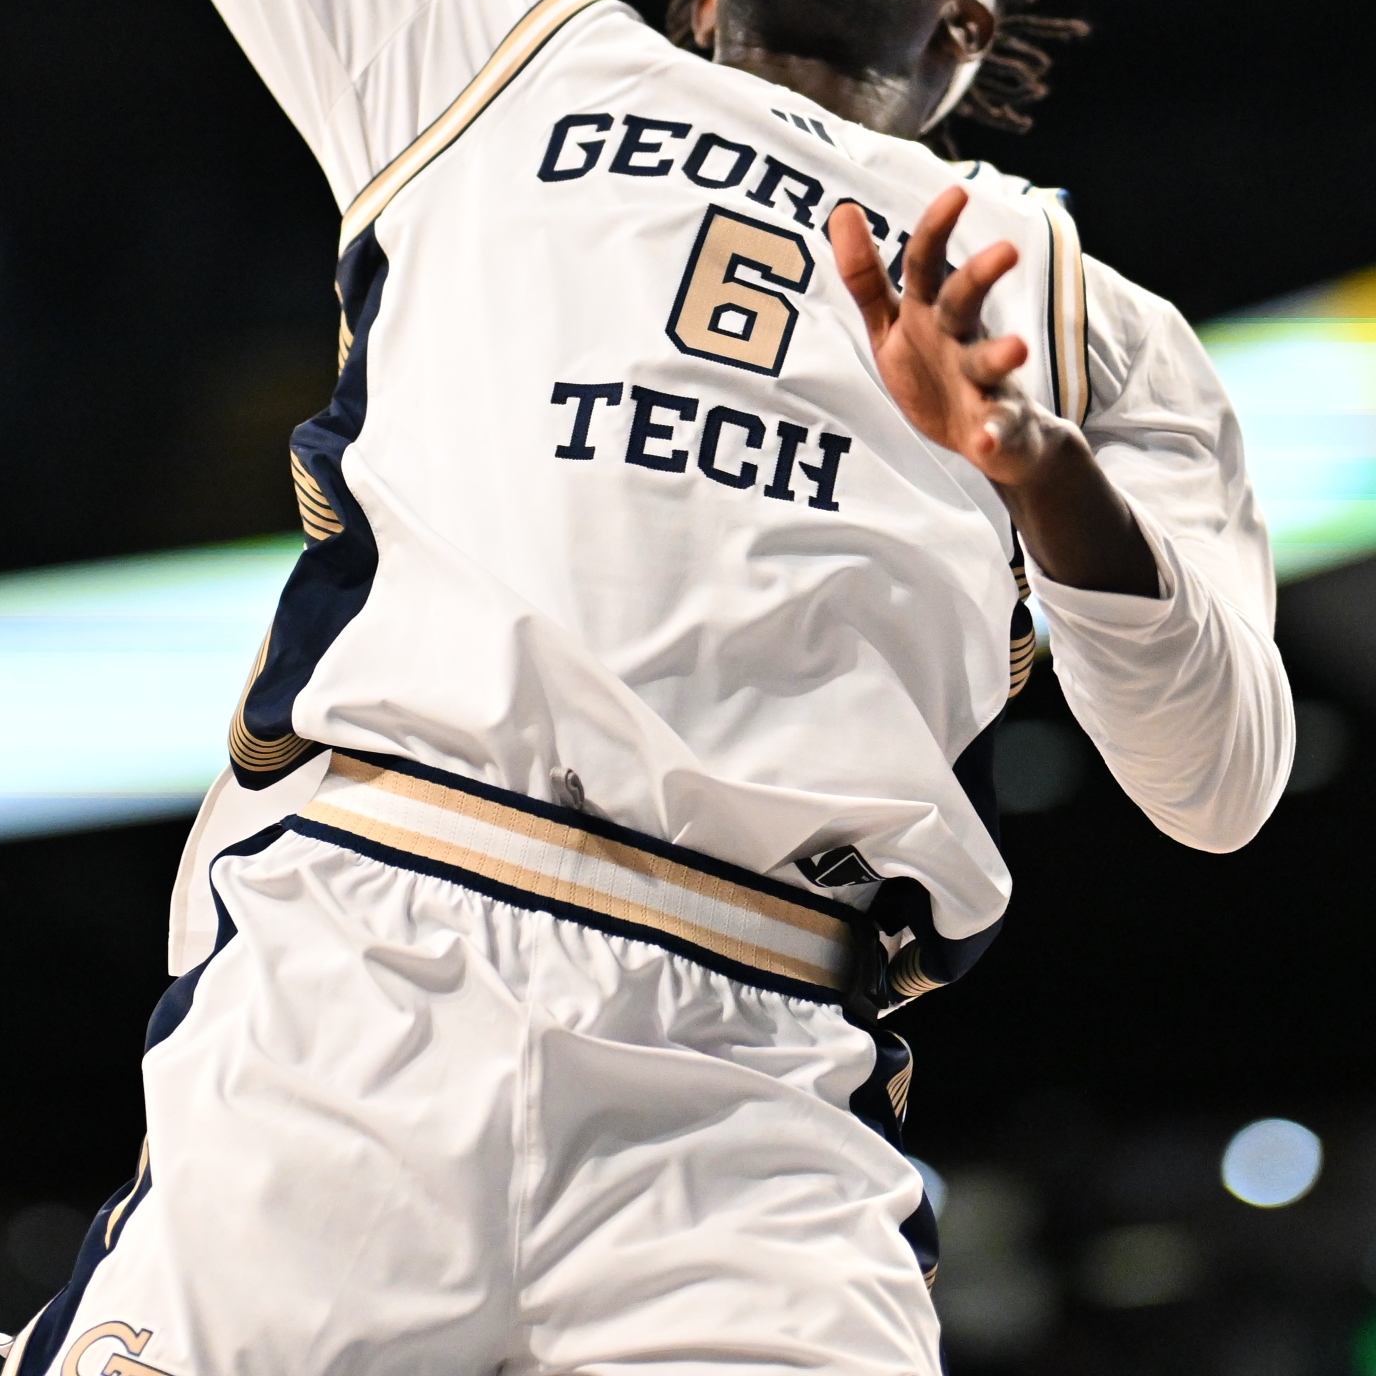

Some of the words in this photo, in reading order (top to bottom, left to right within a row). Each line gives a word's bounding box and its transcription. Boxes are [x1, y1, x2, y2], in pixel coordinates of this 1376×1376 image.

[536, 112, 959, 294] GEOR
[665, 203, 815, 378] 6
[550, 381, 852, 512] TECH
